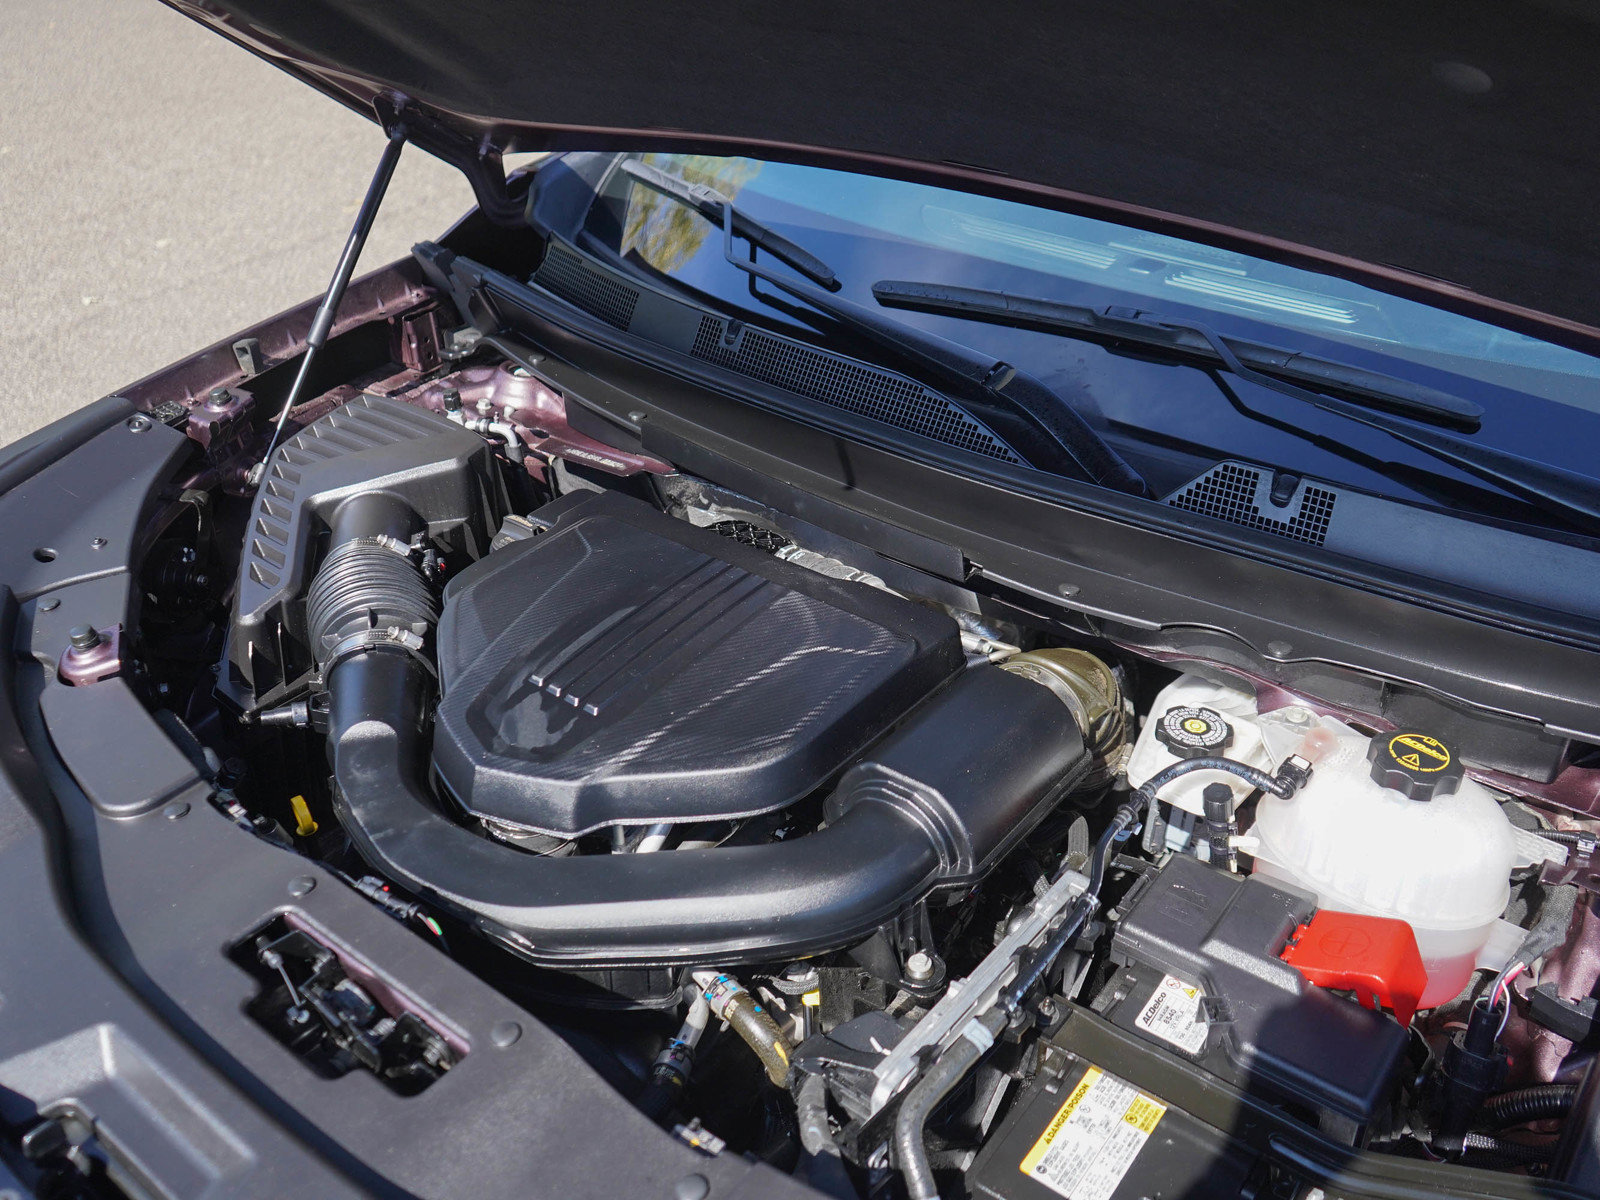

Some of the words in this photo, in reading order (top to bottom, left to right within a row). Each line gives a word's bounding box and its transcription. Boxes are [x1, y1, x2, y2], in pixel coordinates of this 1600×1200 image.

[1399, 738, 1448, 761] ACDelco
[1142, 992, 1167, 1025] ACDelco
[1050, 1083, 1089, 1139] DANGER/POISON
